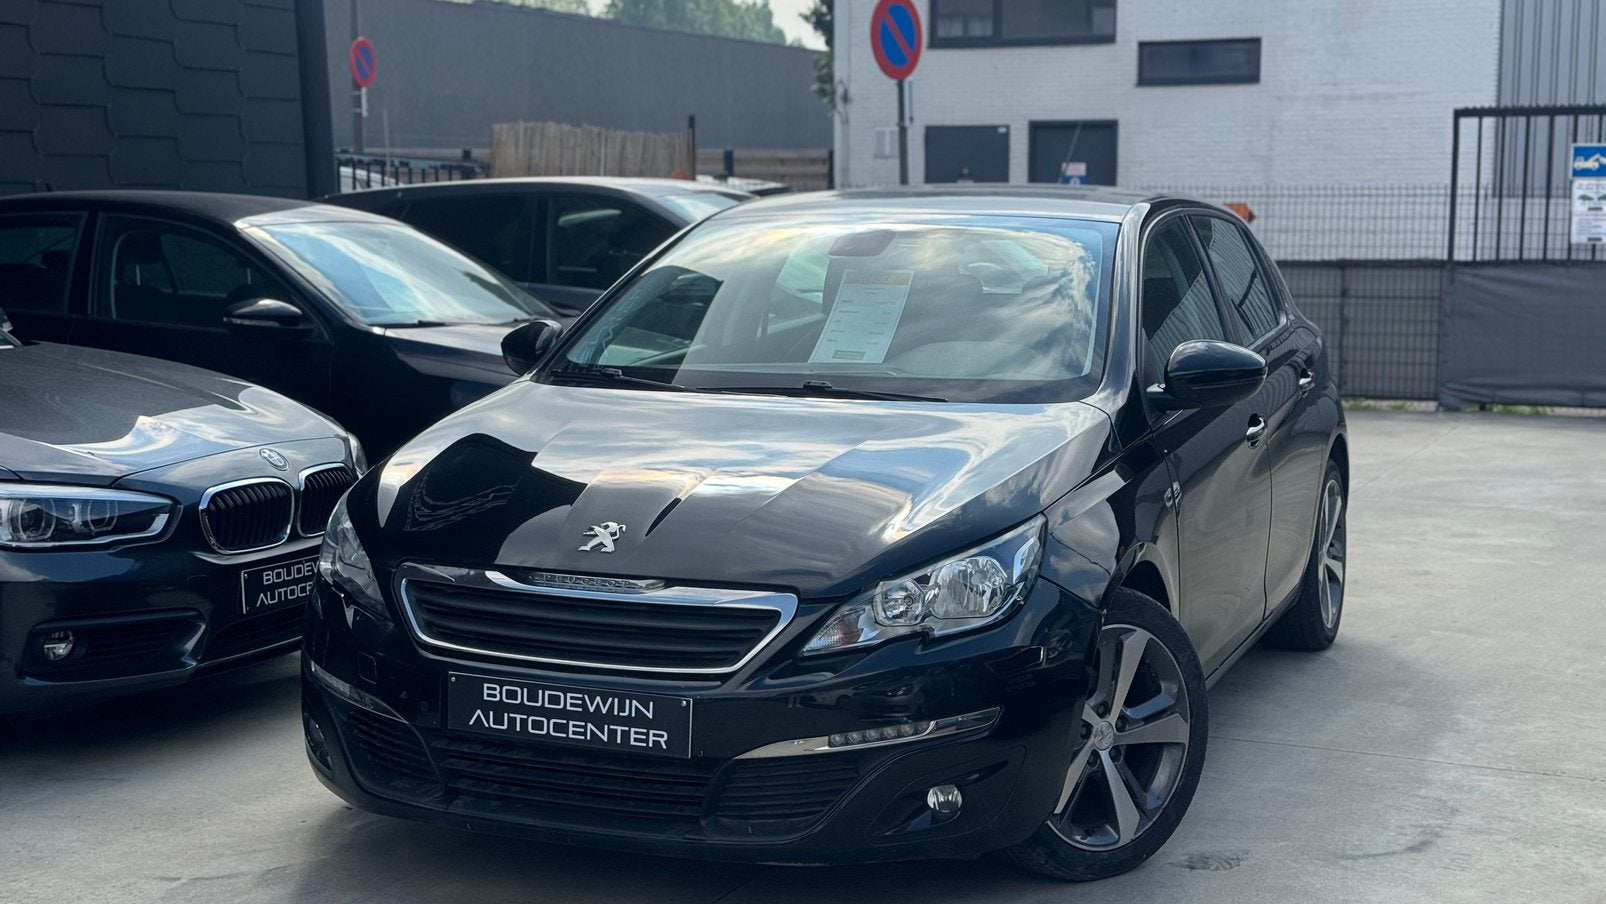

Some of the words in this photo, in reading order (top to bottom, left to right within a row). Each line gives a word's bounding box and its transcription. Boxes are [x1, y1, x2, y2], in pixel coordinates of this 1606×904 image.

[263, 560, 319, 585] BOUDEW
[256, 581, 313, 607] AUTOCE
[483, 682, 654, 719] BOUDEWIJN
[469, 709, 668, 749] AUTOCENTER
